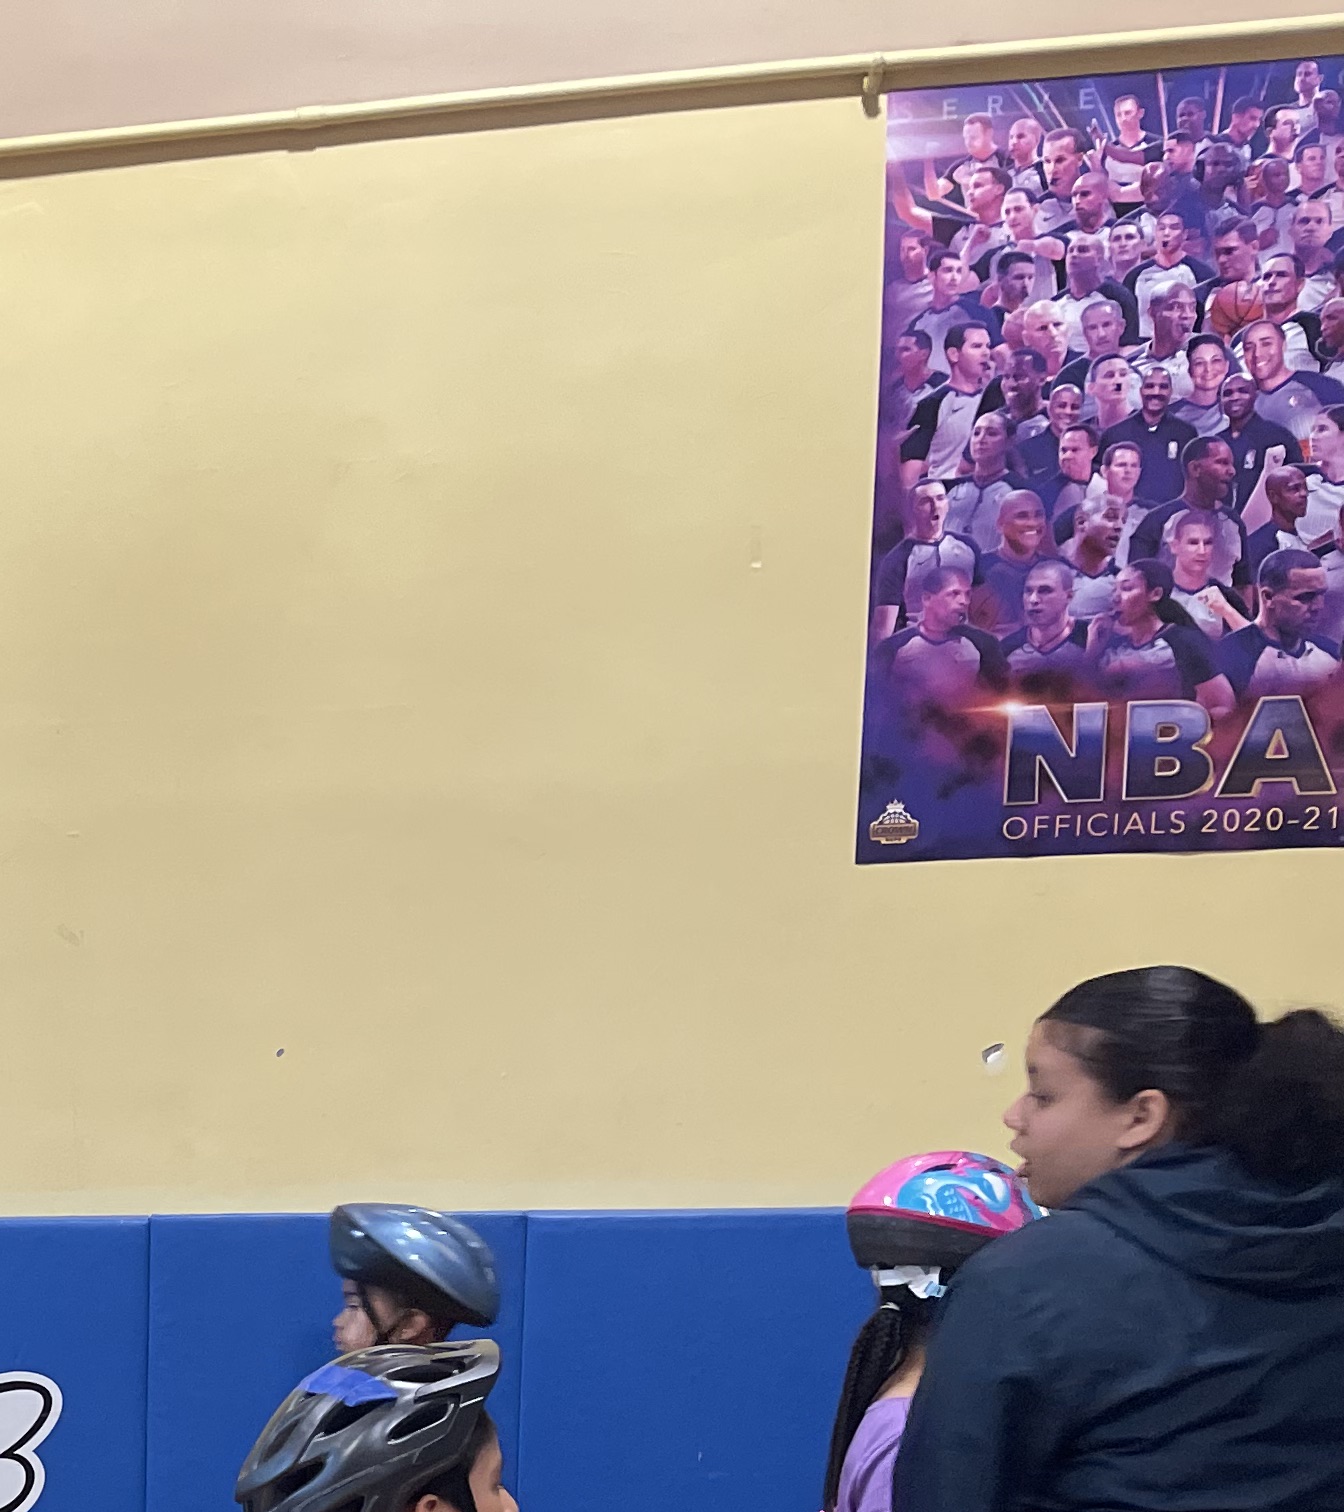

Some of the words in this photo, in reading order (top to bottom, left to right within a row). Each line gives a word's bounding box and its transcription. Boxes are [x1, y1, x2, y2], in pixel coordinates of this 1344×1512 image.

[1002, 694, 1338, 807] NBA
[1002, 809, 1187, 842] OFFICIALS
[1200, 805, 1339, 834] 2020-21
